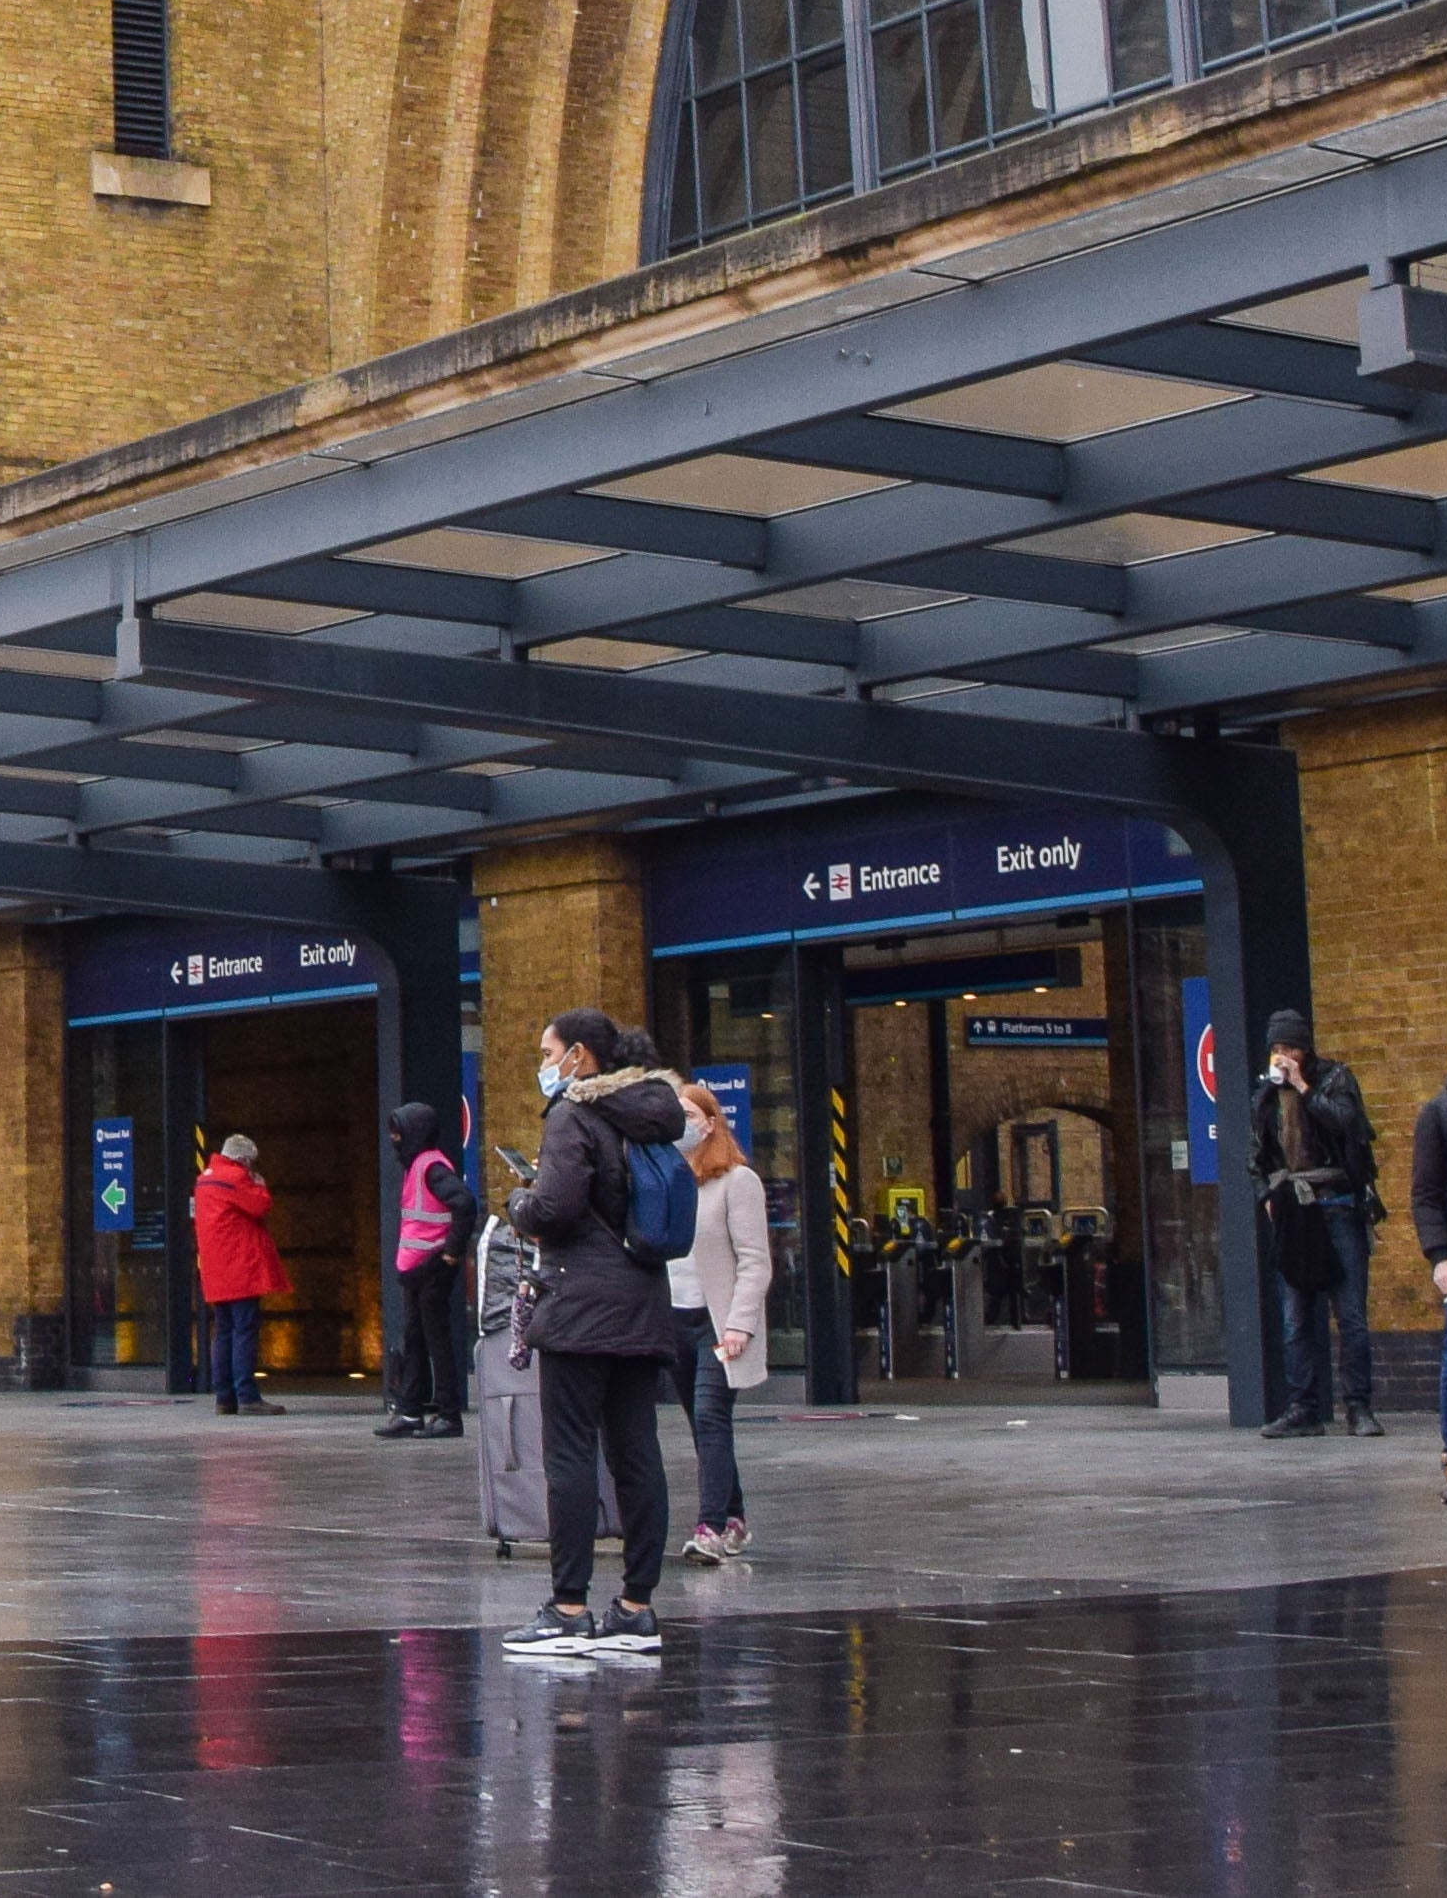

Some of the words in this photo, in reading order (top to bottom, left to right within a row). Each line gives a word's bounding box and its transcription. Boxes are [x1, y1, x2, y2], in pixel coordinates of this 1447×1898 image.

[996, 843, 1035, 873] Exit
[1039, 836, 1082, 870] only
[860, 862, 941, 892] Entrance
[208, 955, 263, 978] Entrance
[299, 944, 325, 967] Exit
[328, 938, 356, 967] only
[1002, 1022, 1045, 1034] Platforms
[1054, 1023, 1065, 1034] to
